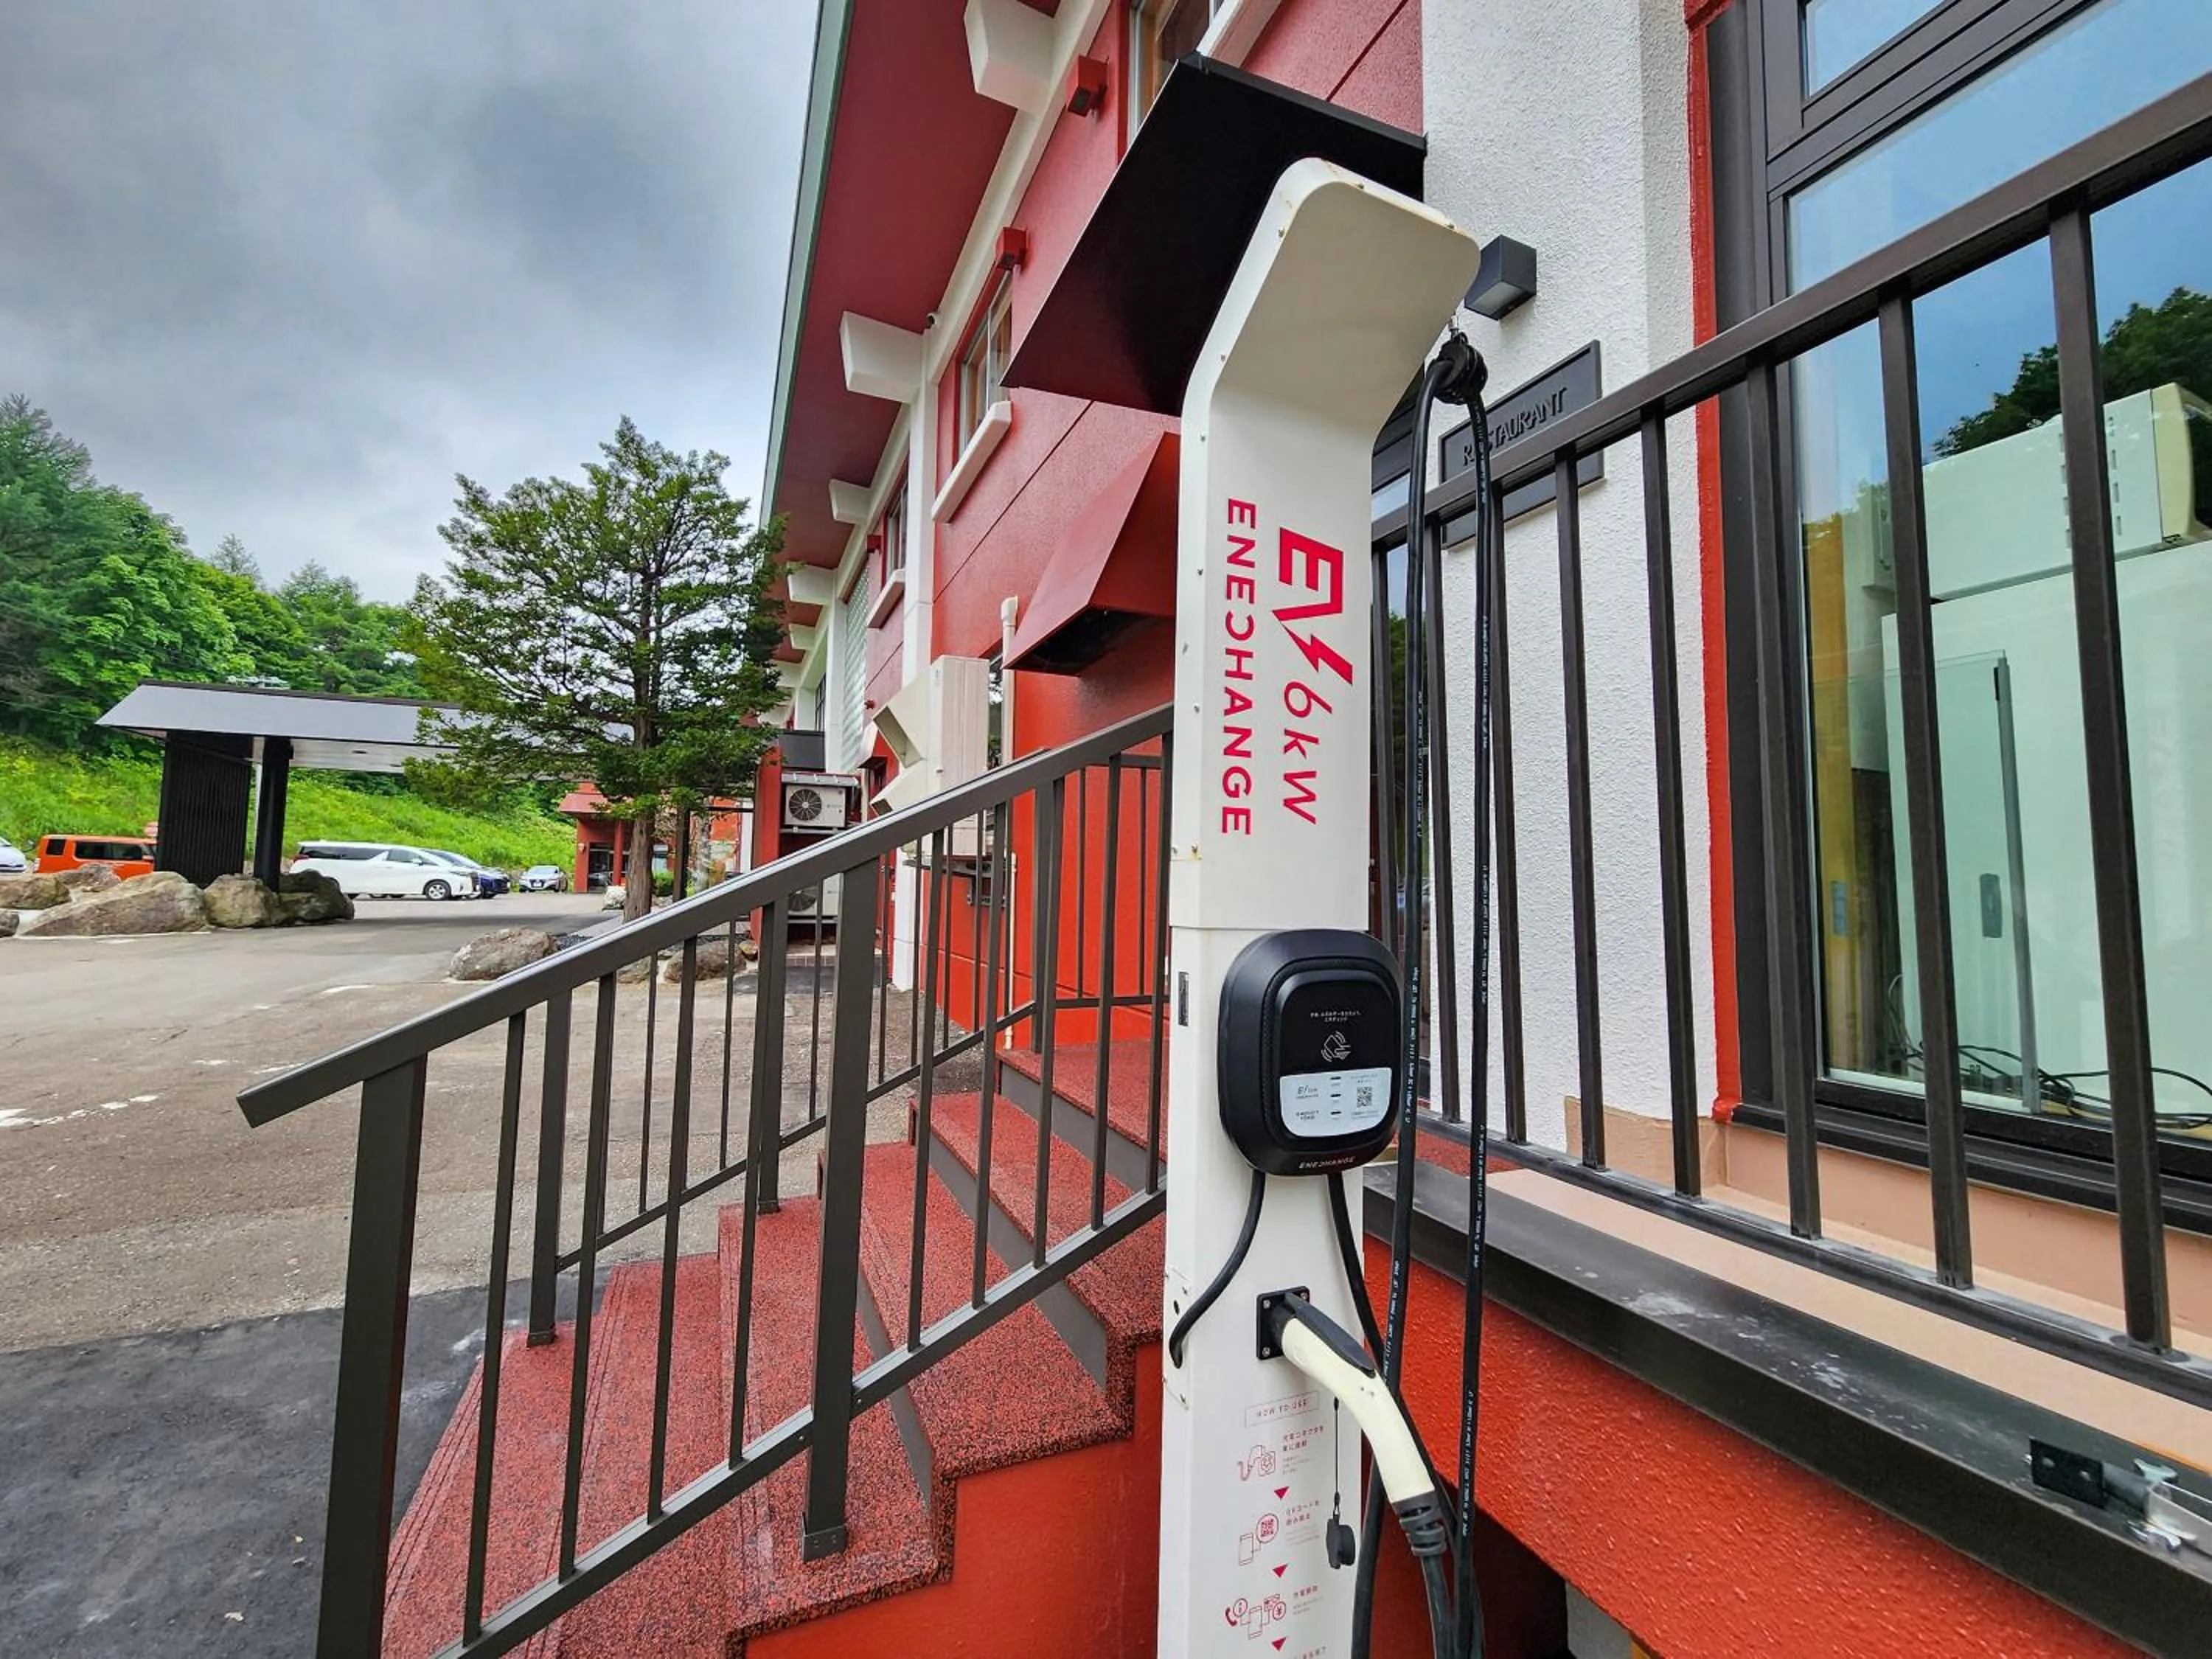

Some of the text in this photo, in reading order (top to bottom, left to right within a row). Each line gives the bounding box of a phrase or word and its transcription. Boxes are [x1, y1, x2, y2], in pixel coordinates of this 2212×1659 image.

[1463, 387, 1568, 467] RSTAURANT
[1221, 498, 1256, 835] ENECHANGE
[1282, 681, 1333, 825] 6kW
